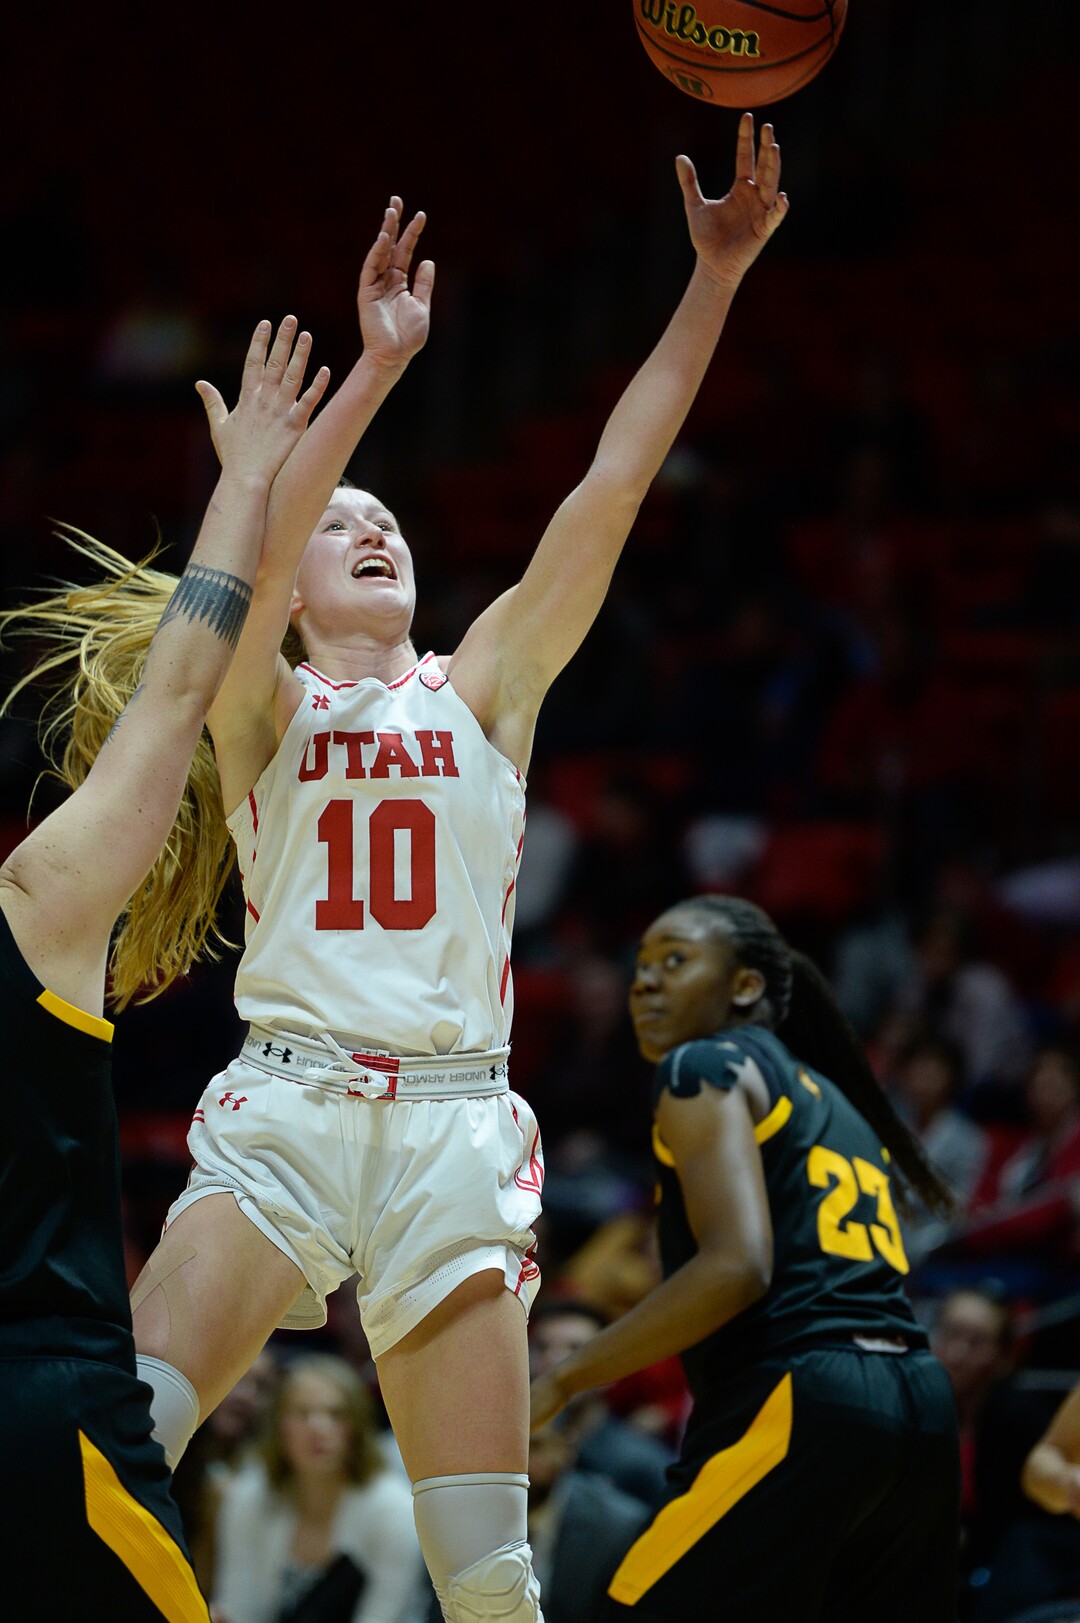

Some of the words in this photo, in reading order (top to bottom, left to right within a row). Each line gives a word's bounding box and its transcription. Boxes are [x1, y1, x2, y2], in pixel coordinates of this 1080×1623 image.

[641, 0, 760, 57] Wilson
[298, 730, 460, 783] UTAH
[315, 799, 437, 930] 10
[449, 1070, 486, 1084] UNDER
[807, 1145, 909, 1275] 23
